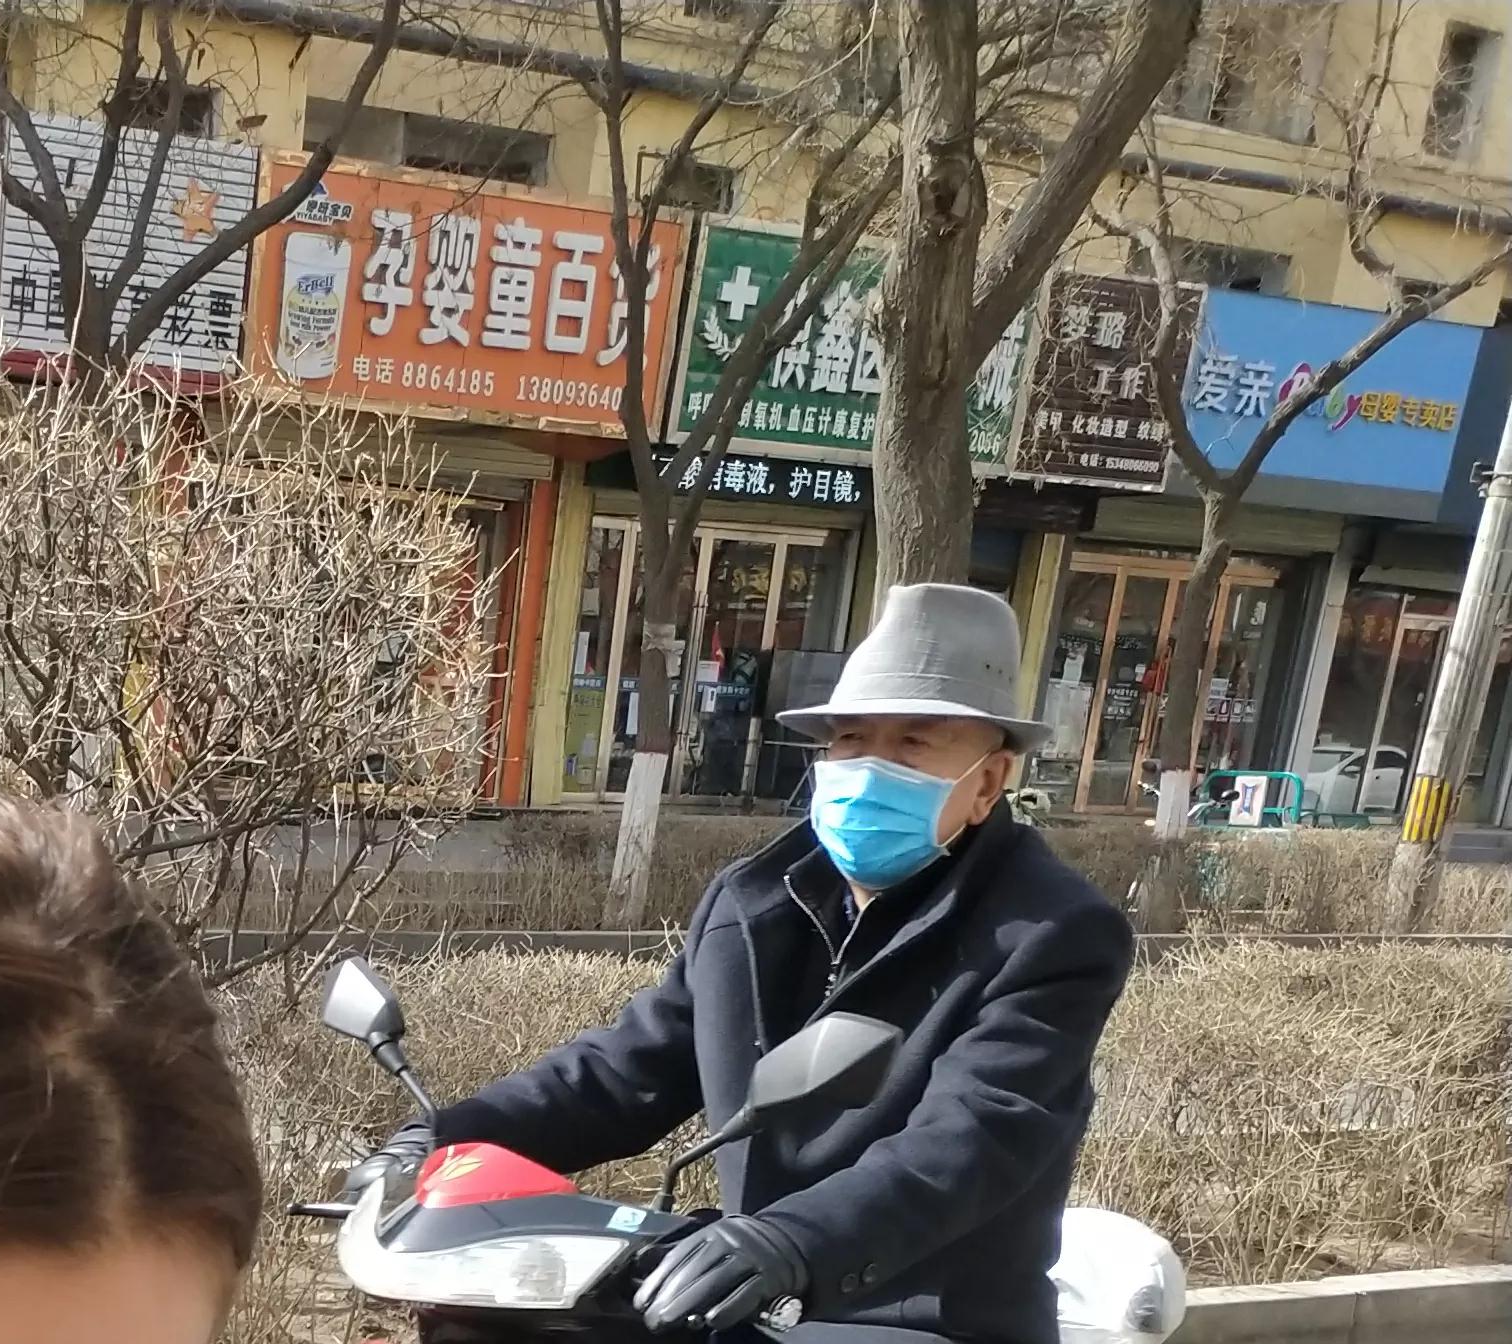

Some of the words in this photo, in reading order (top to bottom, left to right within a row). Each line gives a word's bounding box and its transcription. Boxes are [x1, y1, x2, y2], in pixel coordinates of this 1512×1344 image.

[353, 354, 393, 384] 电话
[402, 361, 494, 396] 8864185
[516, 375, 623, 411] 138093640
[1189, 354, 1276, 418] 爱亲
